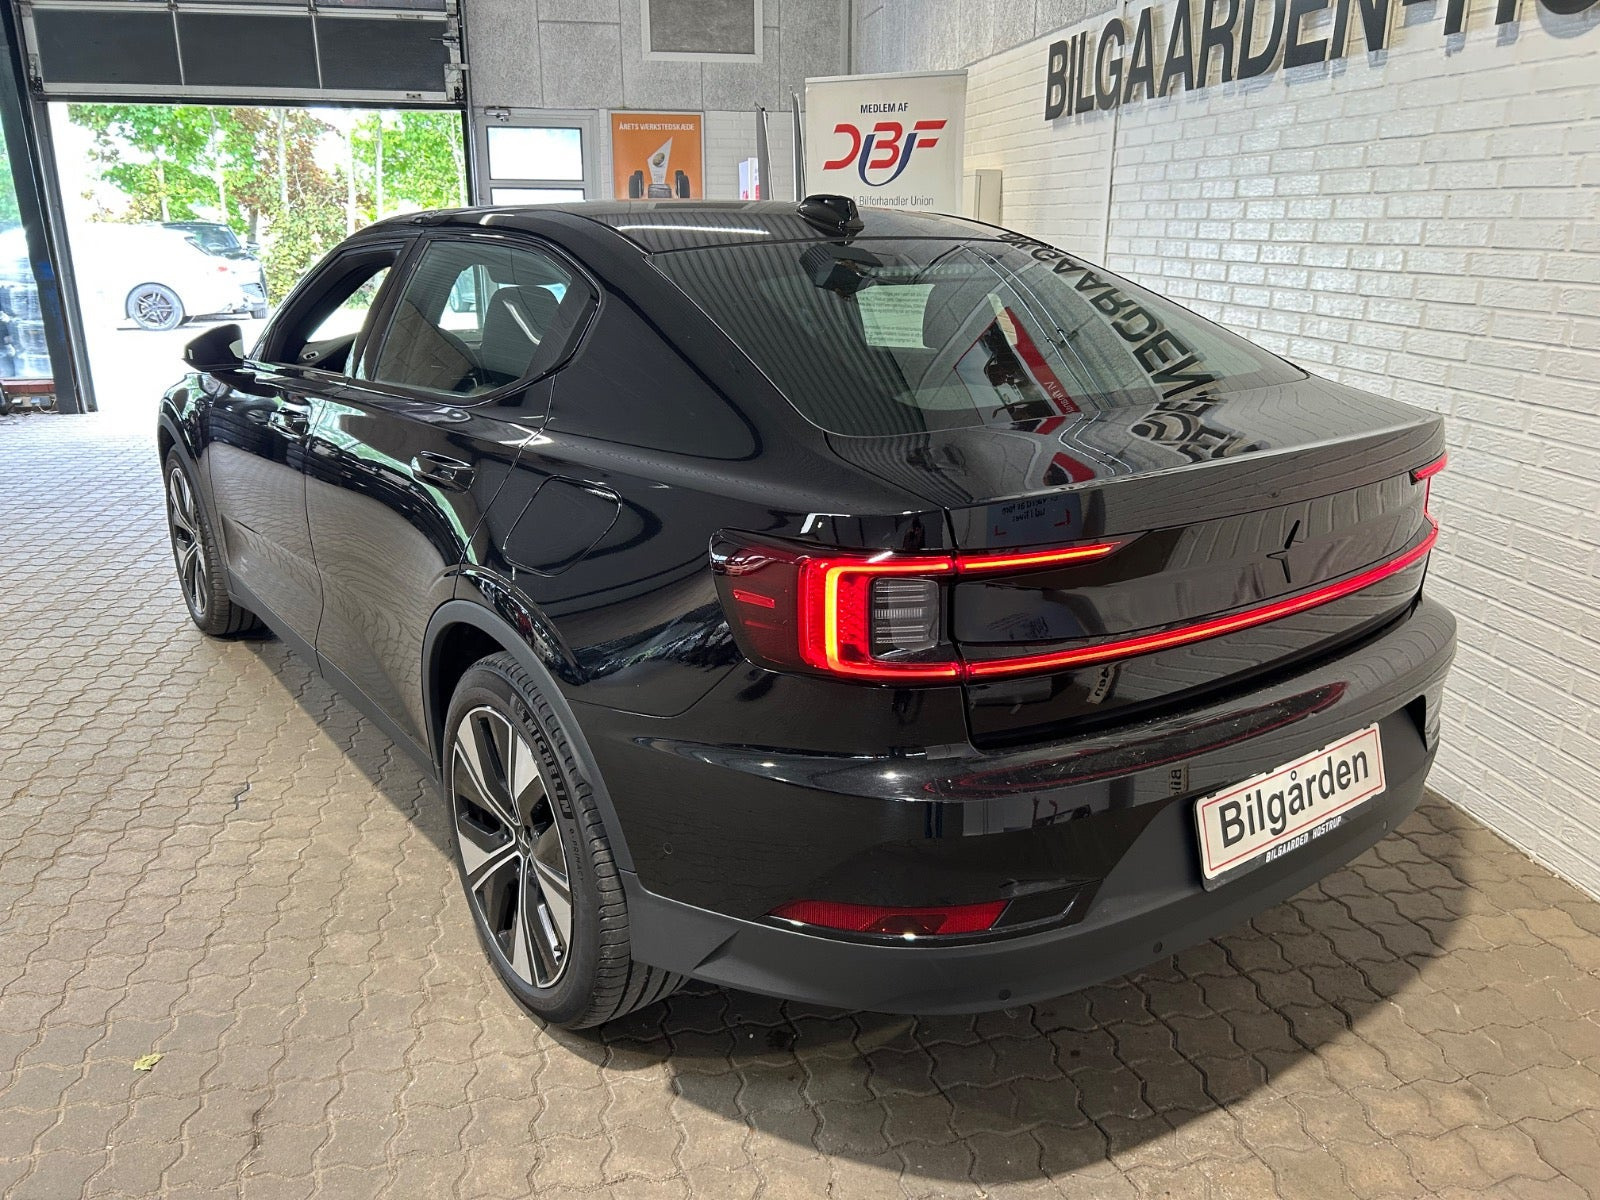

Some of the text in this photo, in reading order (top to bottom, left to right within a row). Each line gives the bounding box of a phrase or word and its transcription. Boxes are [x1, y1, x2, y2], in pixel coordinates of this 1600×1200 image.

[860, 102, 908, 114] MEDLEM AF
[619, 120, 695, 131] ÅRETS VÆRKSTEDSKÆDE
[859, 195, 908, 206] Bilforhandler
[910, 195, 934, 206] Union
[524, 718, 574, 816] MICHELIN
[1218, 750, 1369, 849] Bilgården
[1265, 833, 1309, 863] BILGAARDEN
